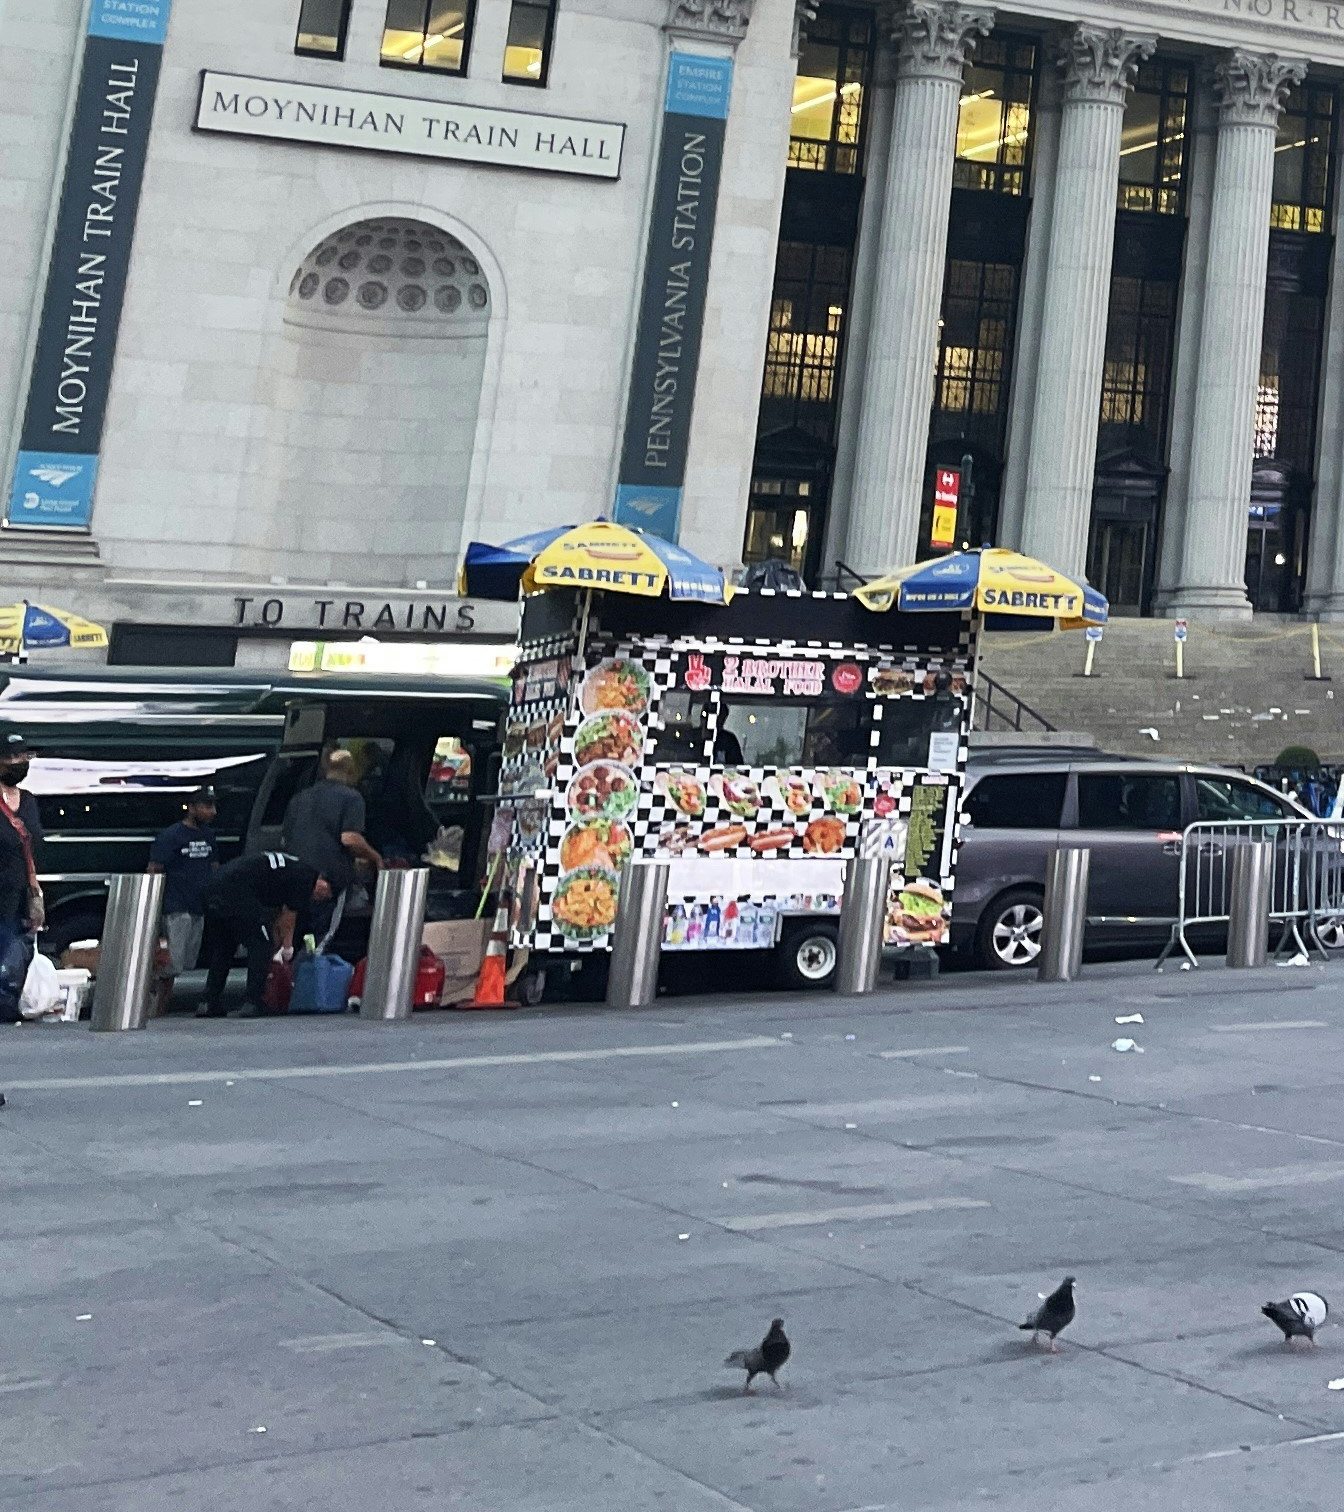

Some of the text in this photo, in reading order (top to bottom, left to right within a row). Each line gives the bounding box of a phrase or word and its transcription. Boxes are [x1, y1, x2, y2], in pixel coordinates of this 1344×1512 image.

[101, 58, 138, 135] HALL
[212, 91, 611, 160] MOYNIHAN TRAIN HALL
[83, 145, 124, 242] TRAIN
[644, 133, 706, 467] PENNSYLVANIA STATION
[52, 253, 106, 435] MOYNIHAN
[543, 565, 660, 588] SABRETT
[983, 589, 1078, 610] SABRETT
[234, 598, 476, 631] TO TRAINS
[884, 836, 895, 849] A
